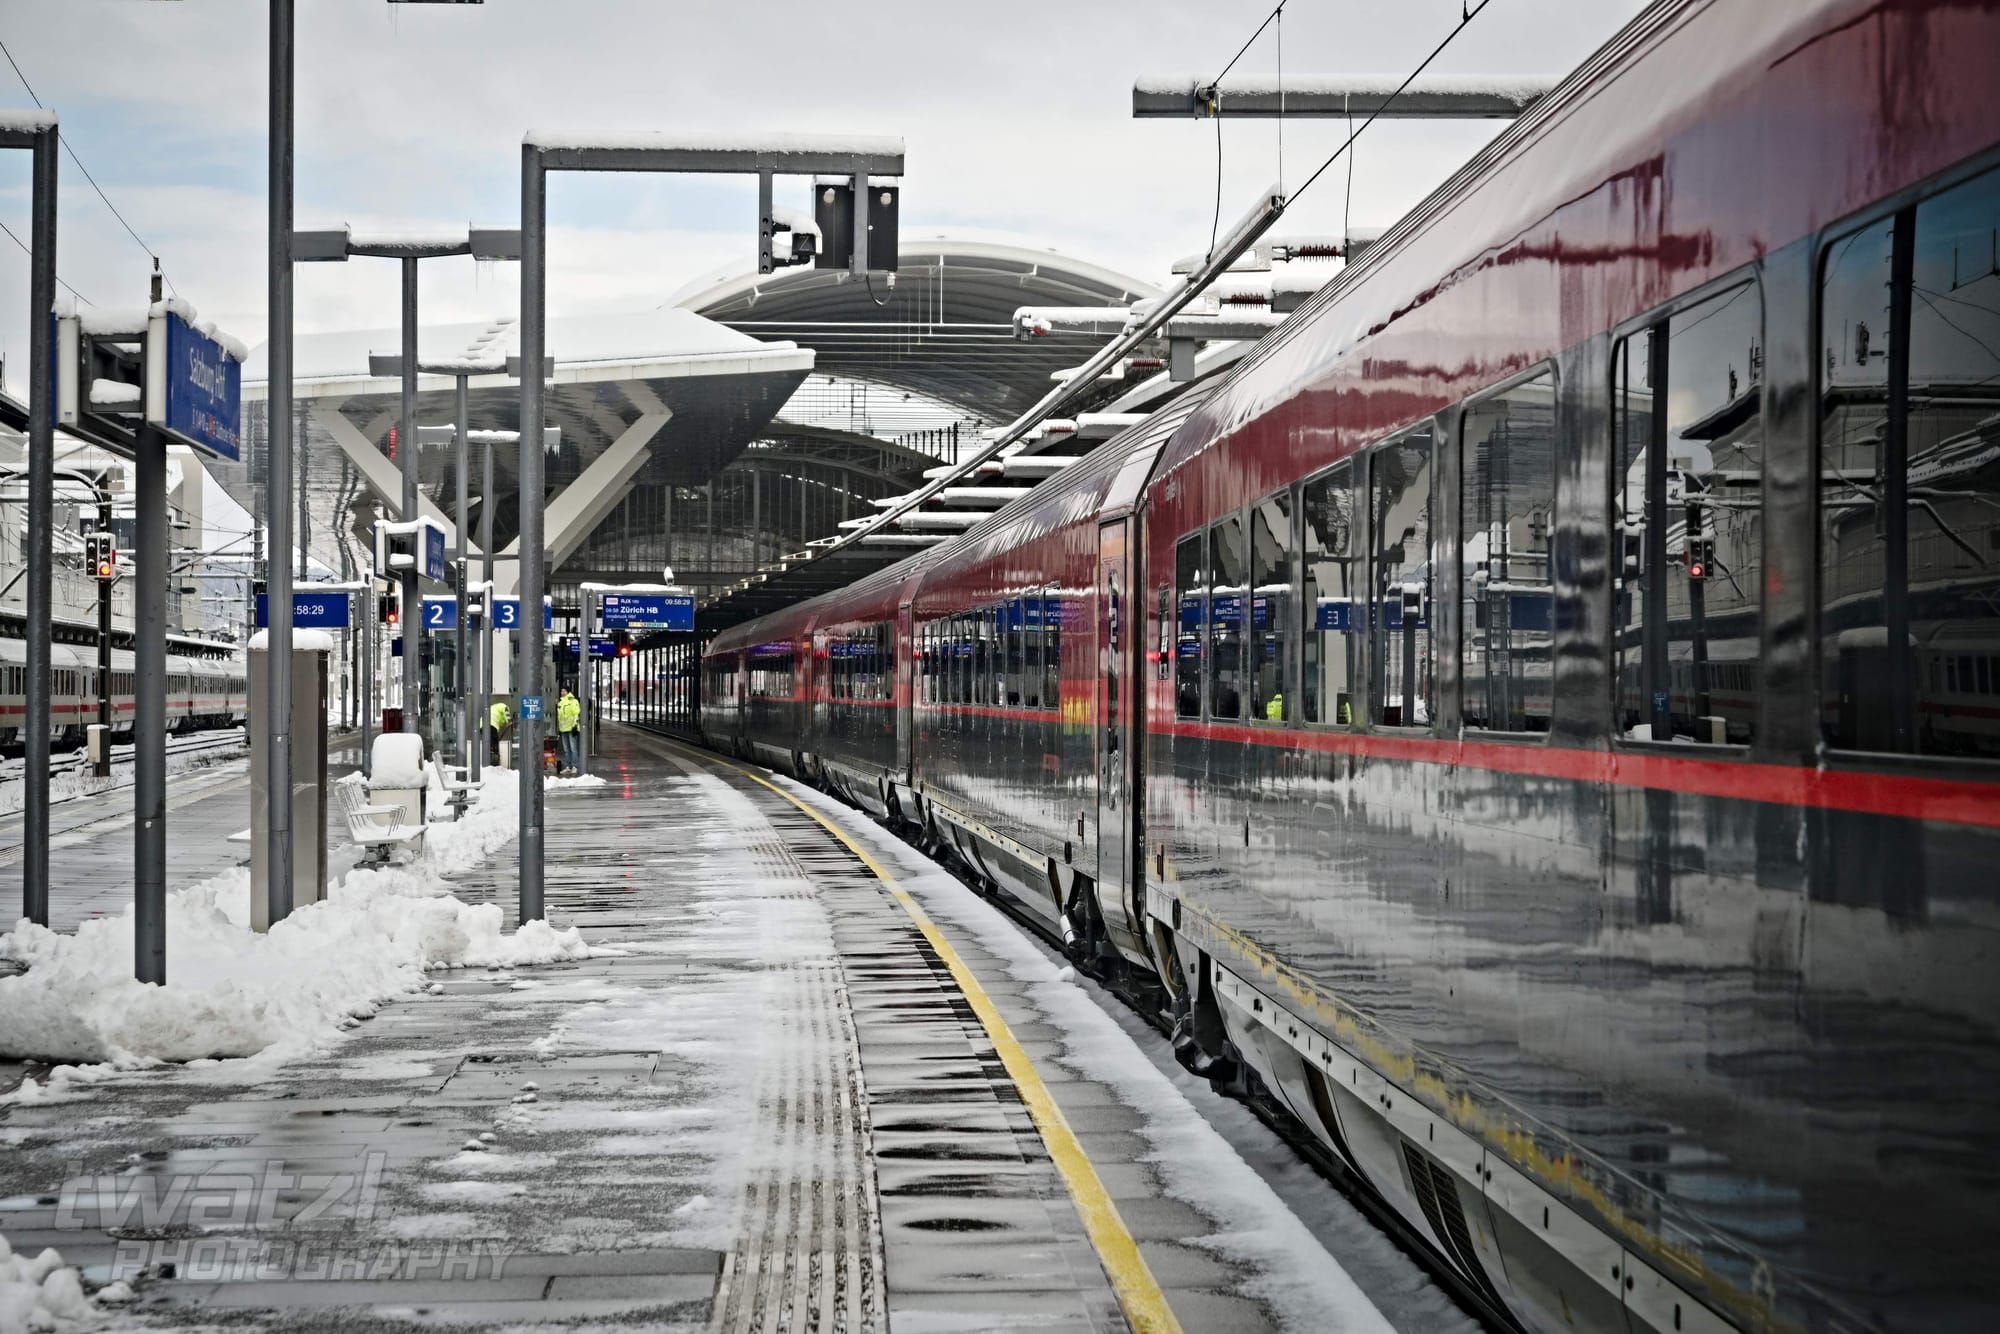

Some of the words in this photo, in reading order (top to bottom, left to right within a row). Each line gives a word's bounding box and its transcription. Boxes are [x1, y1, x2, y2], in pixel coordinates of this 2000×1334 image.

[189, 346, 214, 405] Salzburg
[293, 604, 324, 615] :58:29
[430, 604, 443, 624] 2
[501, 604, 515, 624] 3
[620, 606, 645, 614] Zürich
[646, 606, 659, 614] HB
